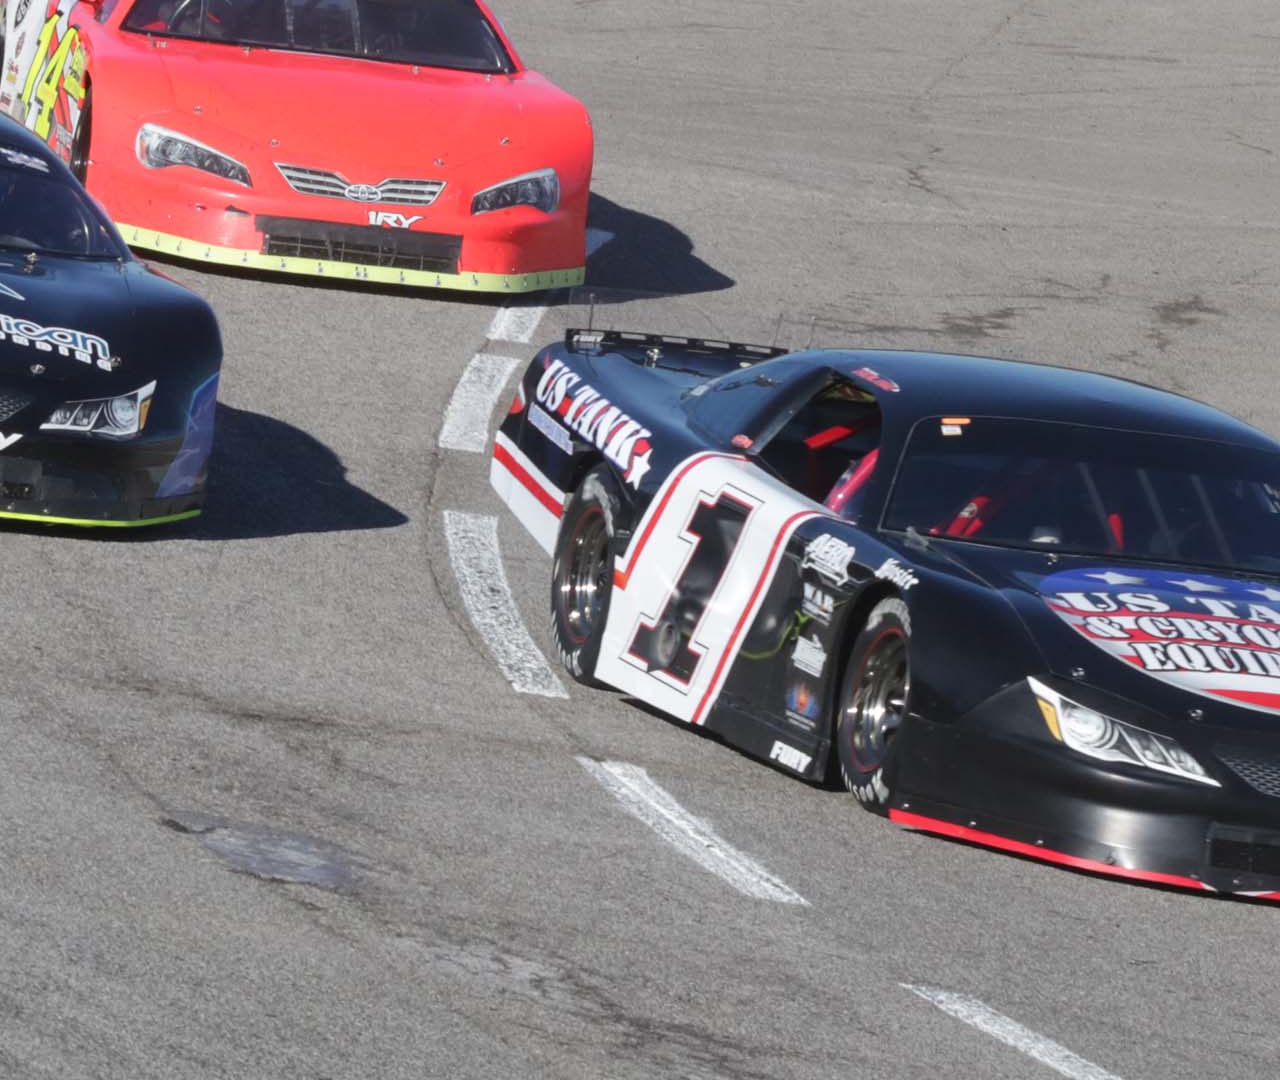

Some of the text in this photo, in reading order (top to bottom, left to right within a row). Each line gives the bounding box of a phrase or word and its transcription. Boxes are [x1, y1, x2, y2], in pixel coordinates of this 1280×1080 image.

[22, 11, 80, 142] 14
[536, 359, 582, 413] US
[563, 384, 653, 473] TANK
[625, 488, 758, 690] 1
[1056, 591, 1171, 615] US
[1081, 614, 1132, 640] &
